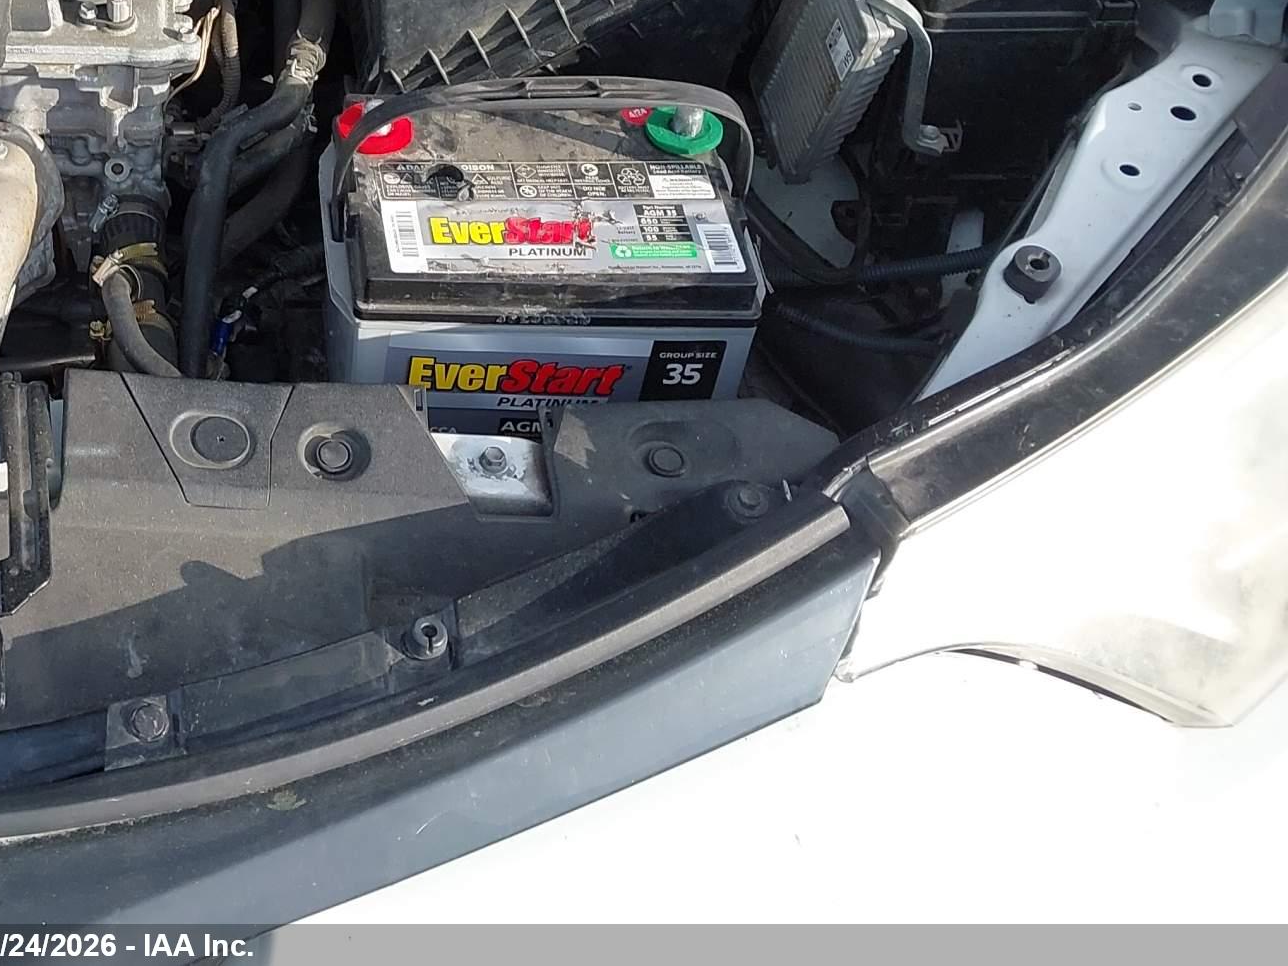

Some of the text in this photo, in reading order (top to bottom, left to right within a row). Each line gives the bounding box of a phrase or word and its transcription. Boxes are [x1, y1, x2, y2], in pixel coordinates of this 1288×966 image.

[428, 216, 593, 245] EverStart
[508, 247, 587, 257] PLATINUM
[408, 355, 624, 395] EverStart
[662, 363, 704, 385] 35
